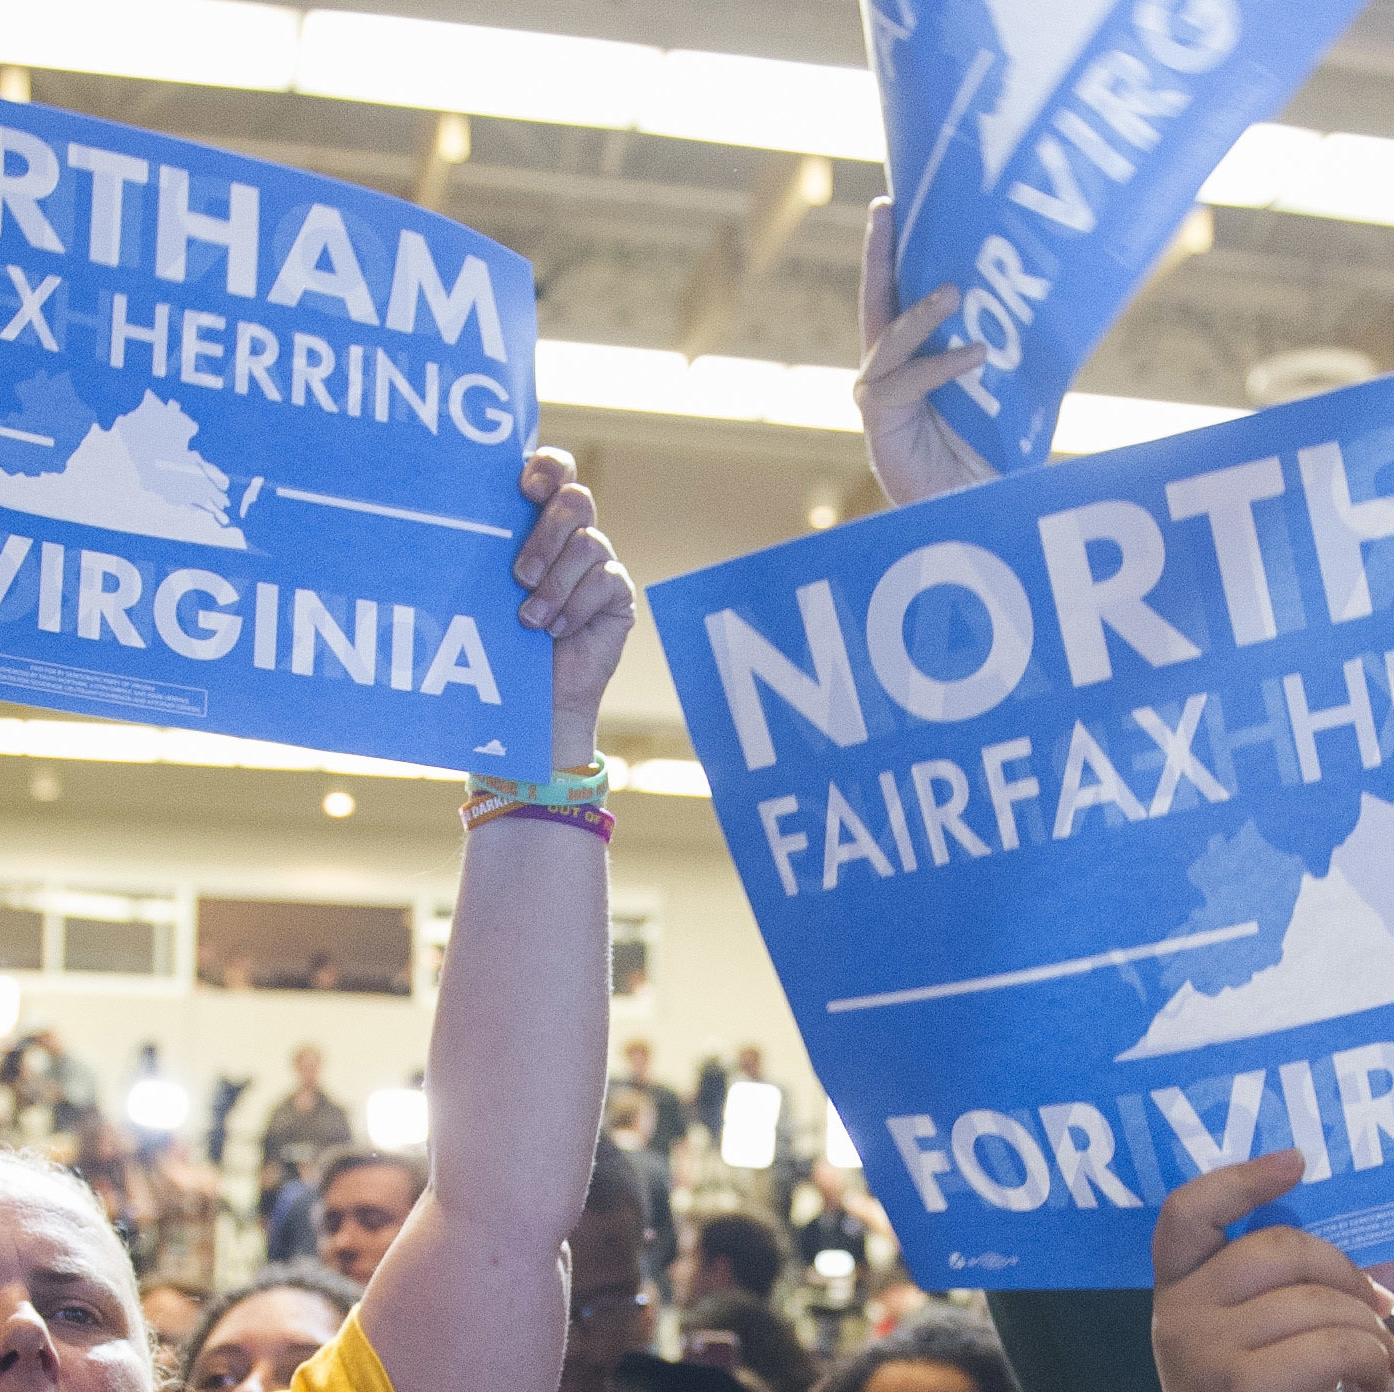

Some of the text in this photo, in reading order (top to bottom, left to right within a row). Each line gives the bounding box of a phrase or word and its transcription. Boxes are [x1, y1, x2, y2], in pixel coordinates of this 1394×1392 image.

[110, 294, 514, 446] HERRING
[757, 693, 1231, 896] FAIRFAX
[886, 1101, 1135, 1213] FOR
